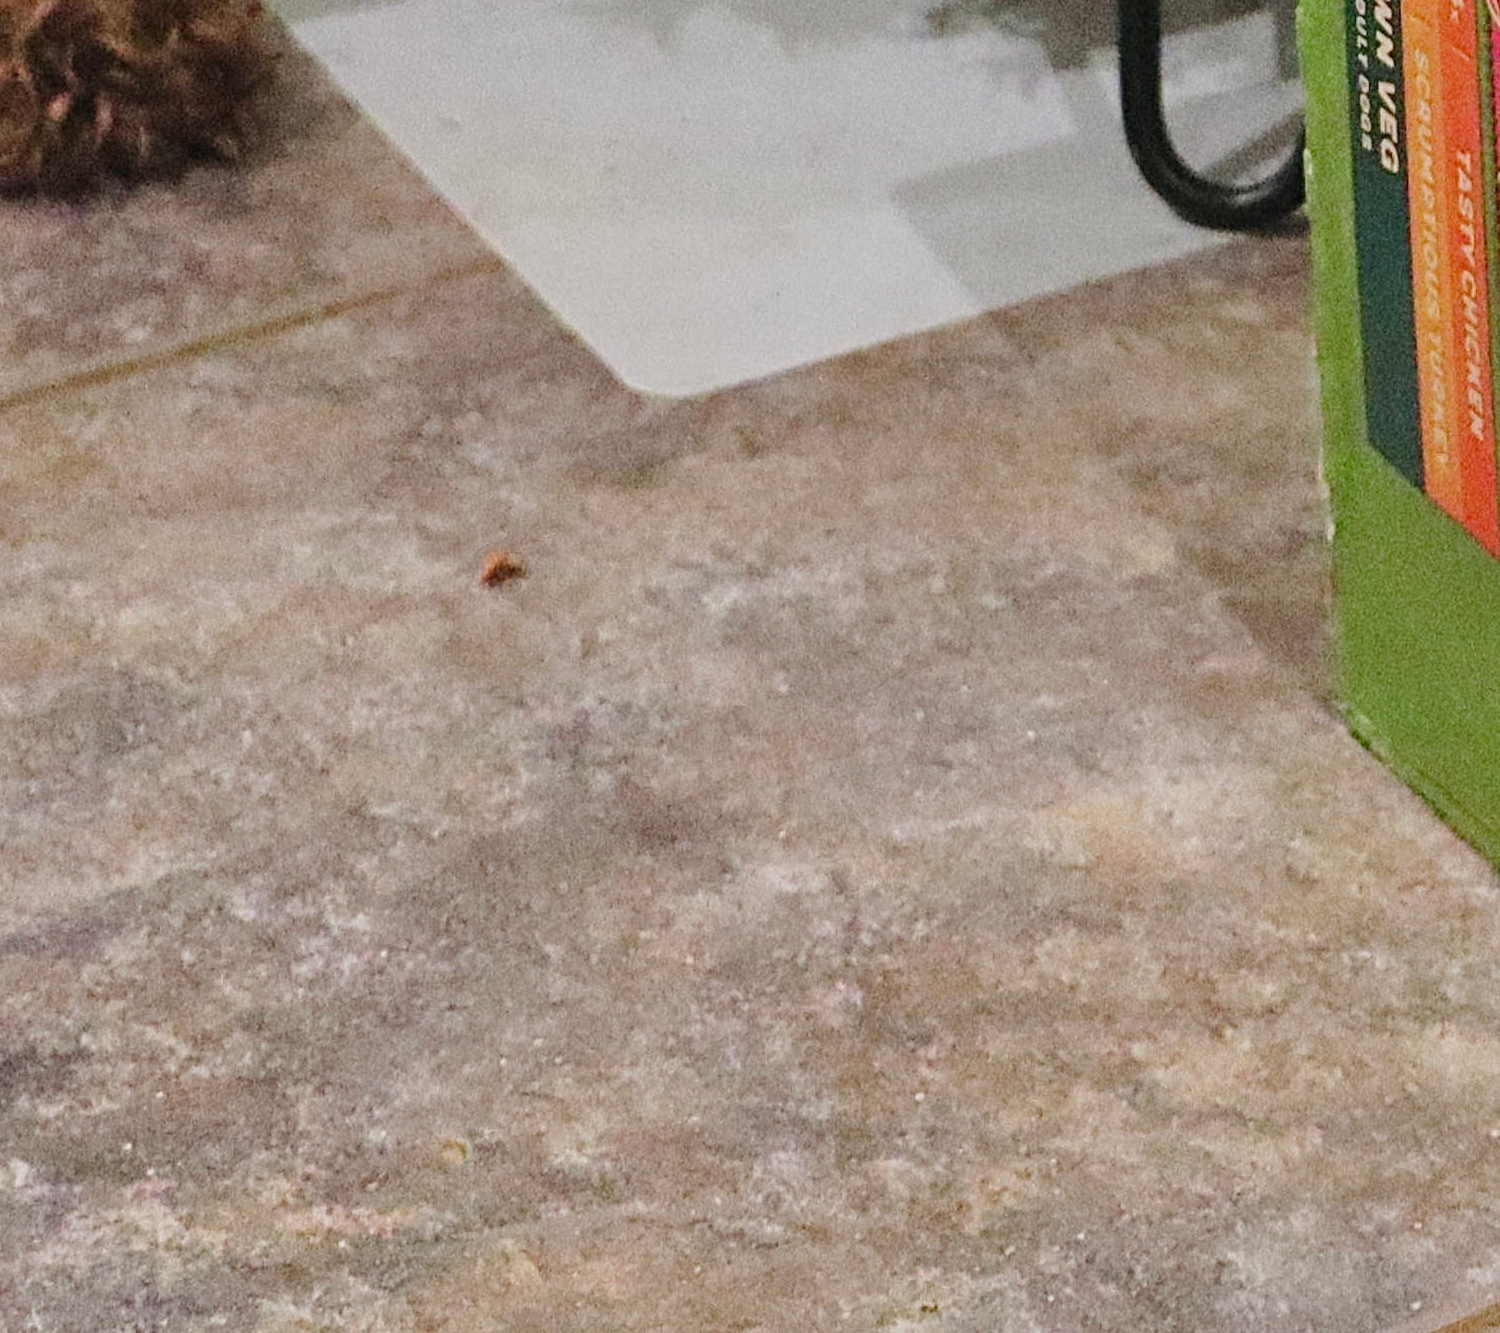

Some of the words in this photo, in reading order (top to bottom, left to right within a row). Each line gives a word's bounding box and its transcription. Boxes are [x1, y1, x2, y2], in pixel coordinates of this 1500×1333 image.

[1378, 80, 1400, 174] VEG
[1456, 149, 1477, 268] TASTY
[1461, 269, 1485, 442] CHICKEN
